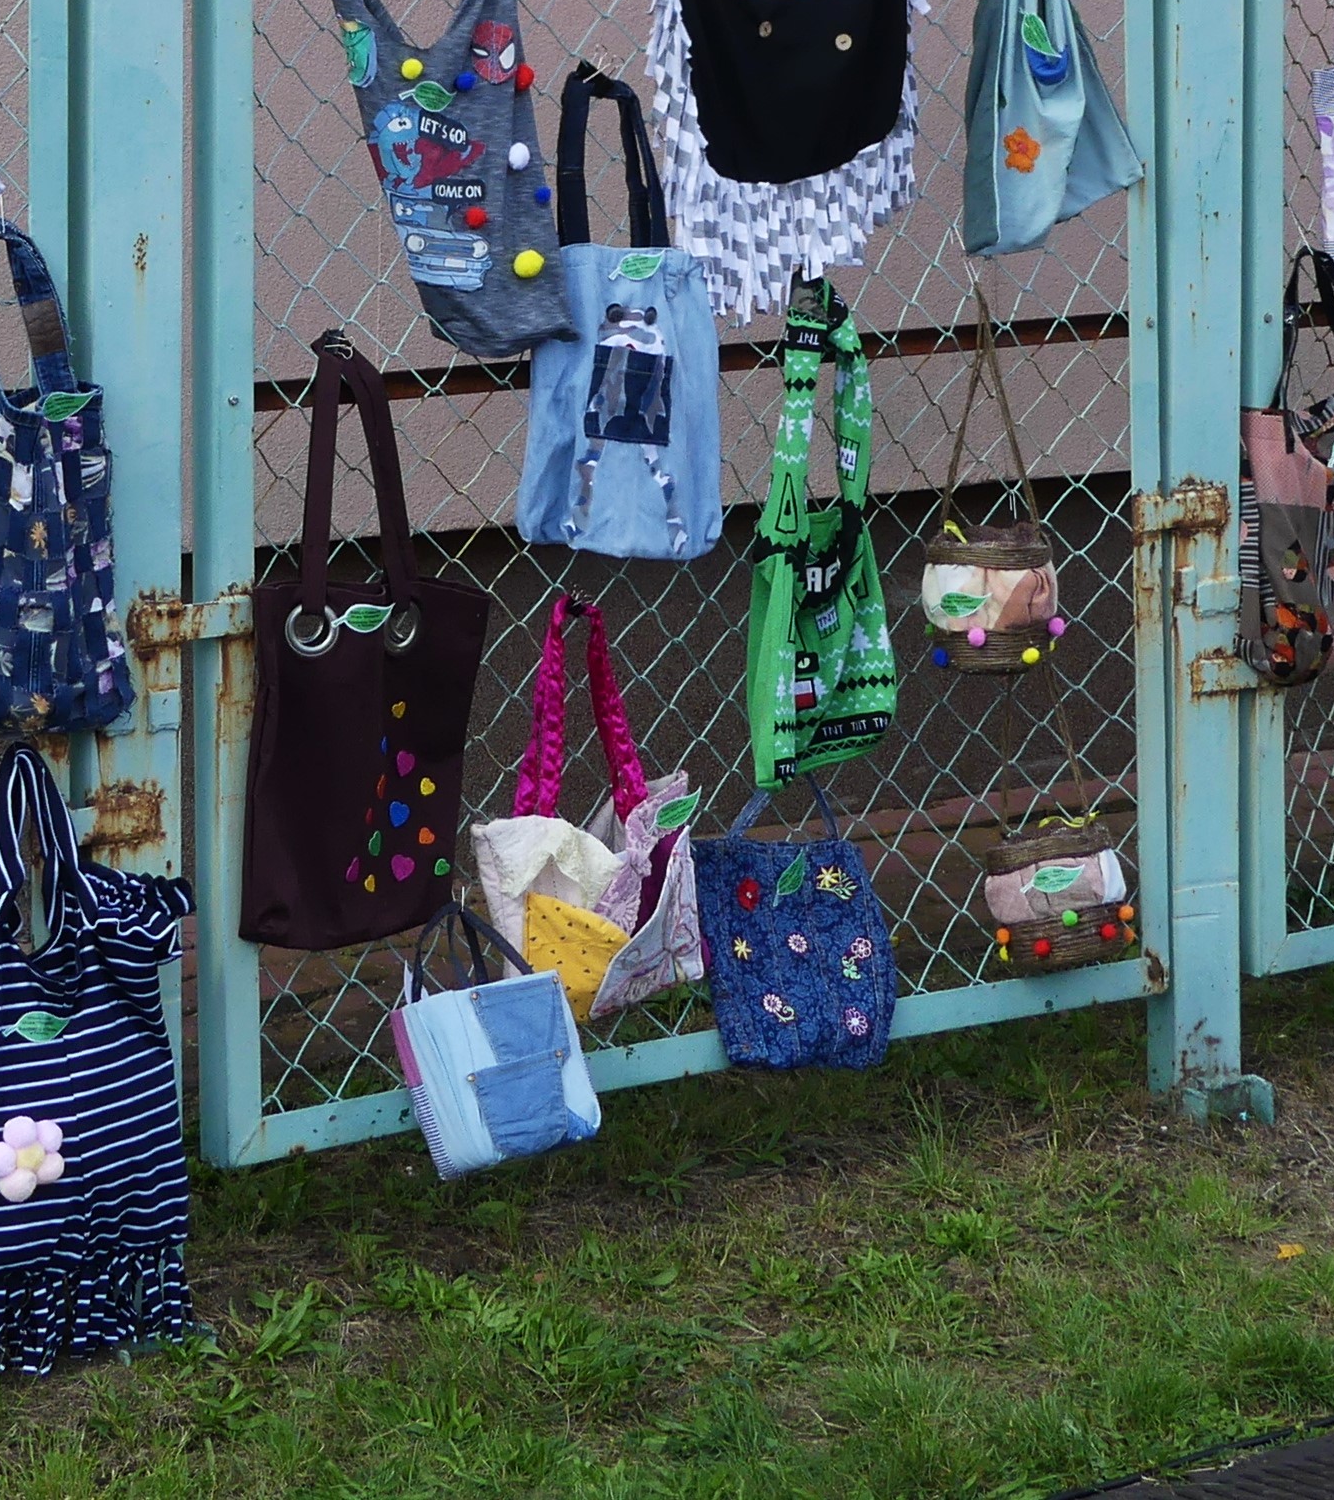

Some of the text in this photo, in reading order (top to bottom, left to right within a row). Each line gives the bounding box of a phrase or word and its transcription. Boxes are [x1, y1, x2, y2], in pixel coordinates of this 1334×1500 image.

[420, 116, 467, 145] LET'S GO!
[435, 184, 482, 198] COME ON
[818, 608, 836, 628] TNT
[821, 724, 844, 737] TNT
[872, 716, 888, 729] TN
[778, 763, 795, 775] TN
